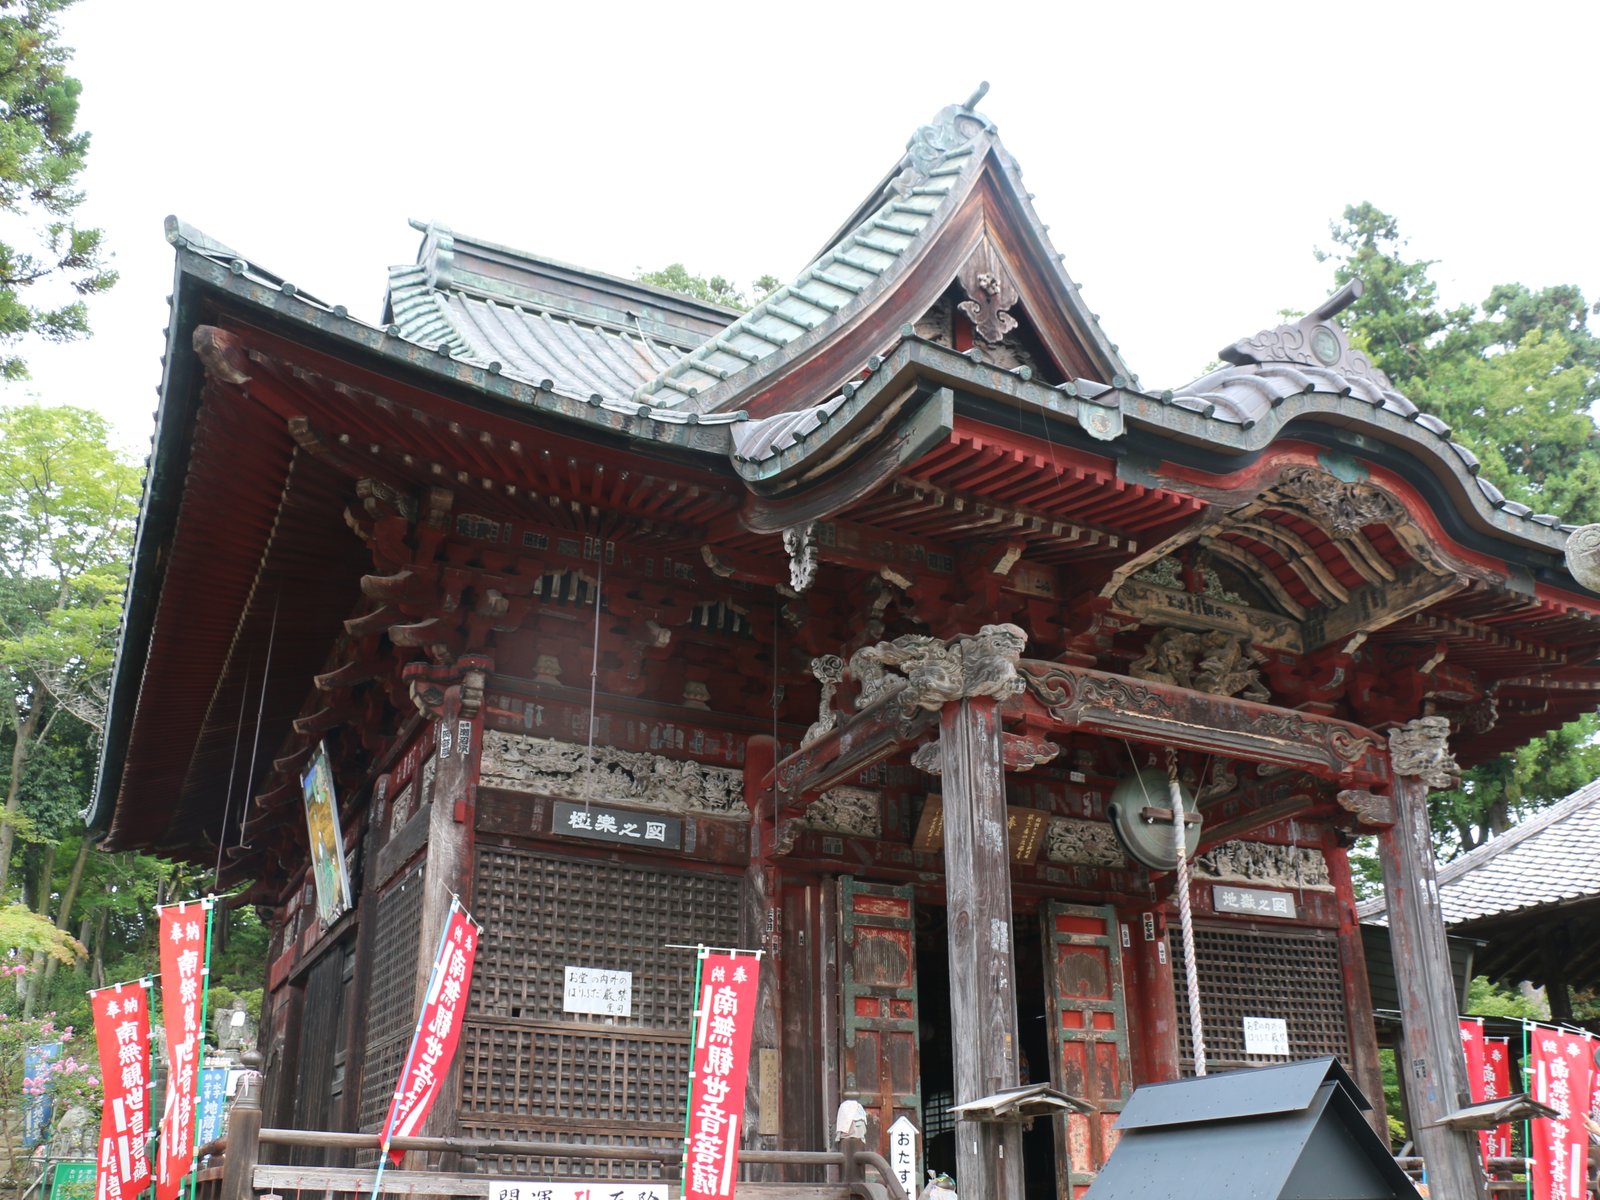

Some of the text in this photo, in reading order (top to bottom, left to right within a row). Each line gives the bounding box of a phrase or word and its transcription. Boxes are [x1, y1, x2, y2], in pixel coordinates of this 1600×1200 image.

[169, 920, 200, 944] 奉納
[105, 996, 139, 1019] 奉納
[115, 1020, 148, 1183] 南無観世音菩薩
